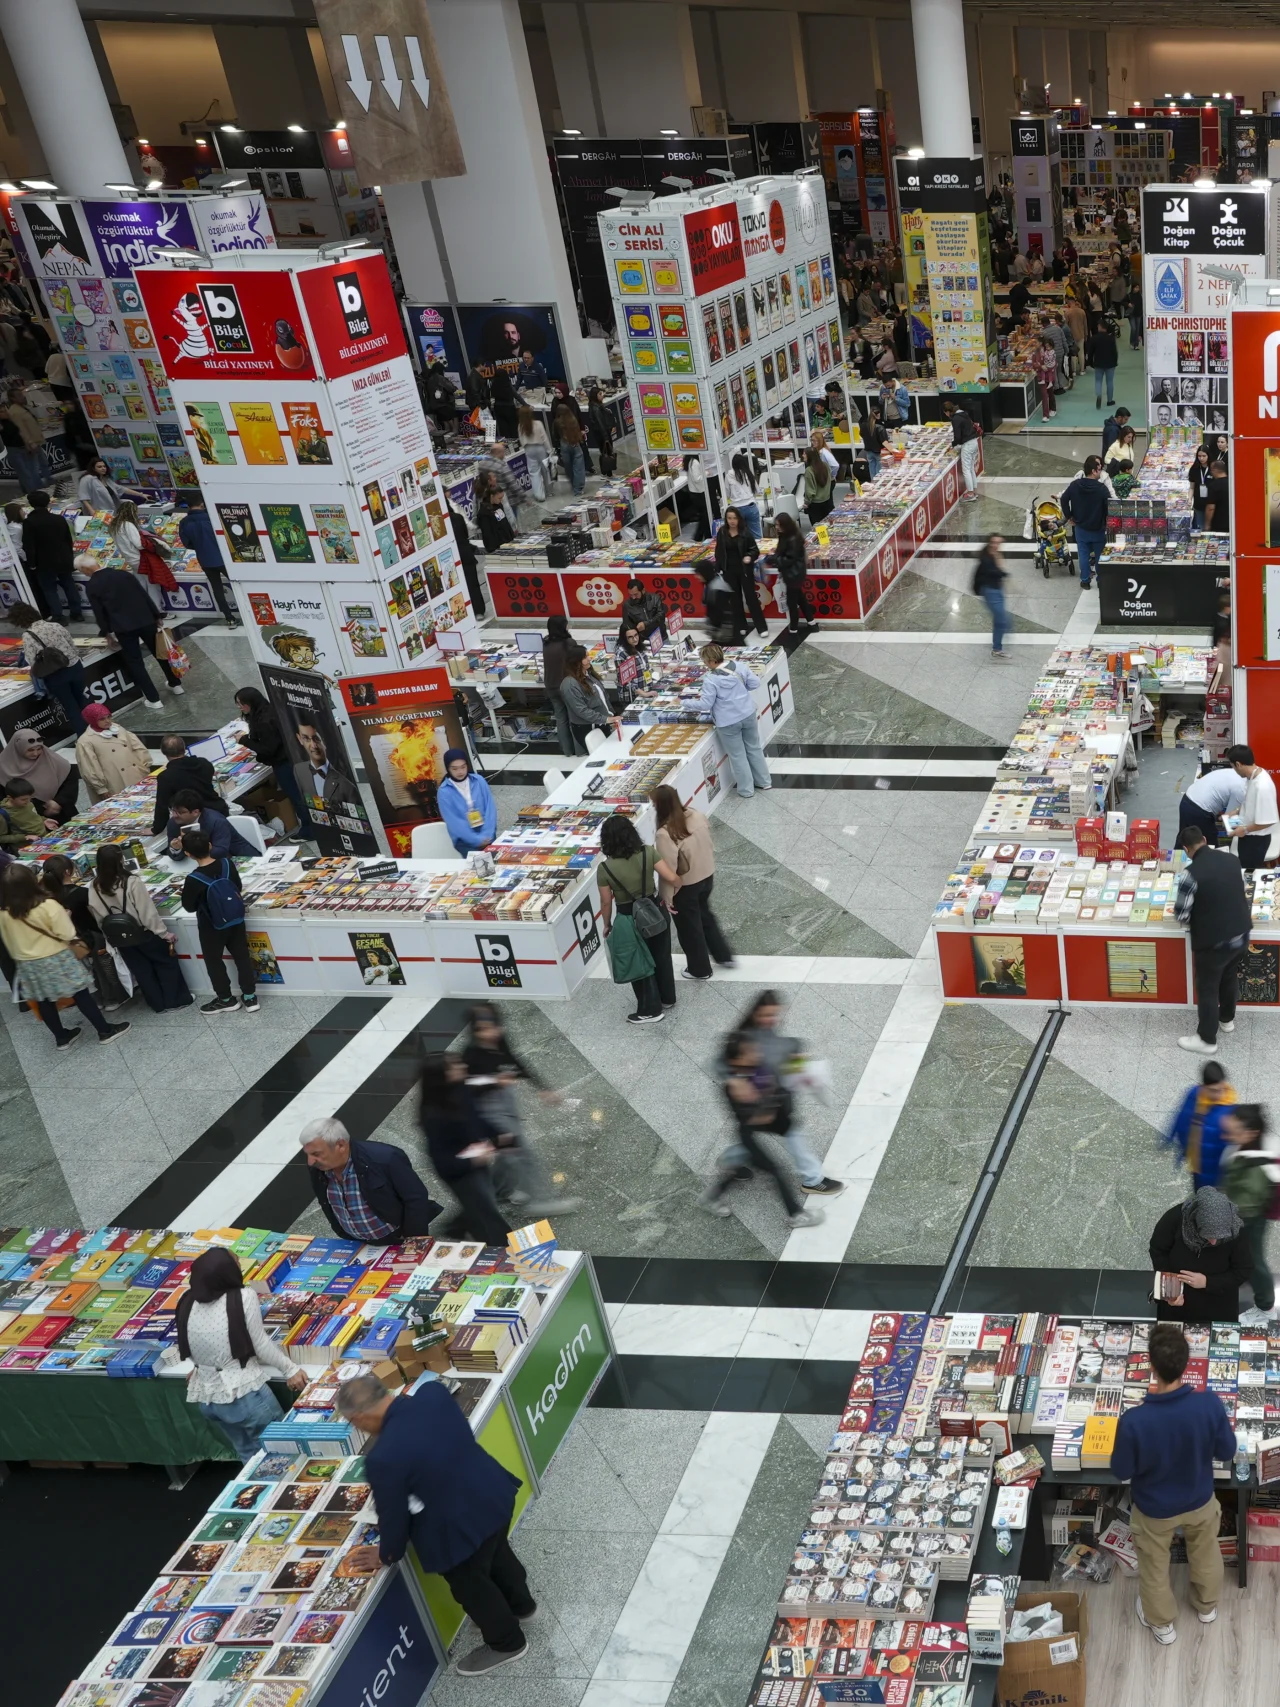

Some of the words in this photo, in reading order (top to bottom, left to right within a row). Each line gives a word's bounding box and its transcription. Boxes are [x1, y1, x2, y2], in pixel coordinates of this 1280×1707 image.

[667, 152, 703, 161] DERGÂH
[934, 174, 959, 183] YKY
[103, 211, 142, 222] okumak
[210, 210, 237, 222] okumak
[97, 224, 154, 237] özgürlüktür
[207, 222, 247, 237] özgürlüktür
[618, 222, 642, 236] CİN
[644, 222, 664, 236] ALİ
[1163, 225, 1196, 236] Doğan
[1211, 226, 1246, 237] Doğan
[936, 232, 966, 240] başlayan
[624, 239, 664, 251] SERİSİ
[937, 244, 966, 252] kitapları
[1163, 237, 1190, 249] Kitap
[1213, 236, 1245, 249] Çocuk
[43, 261, 96, 277] NEPAL
[348, 319, 370, 335] Bilgi
[1146, 316, 1227, 331] JEAN-CHRISTOPHE
[215, 324, 244, 340] Bilgi
[218, 339, 248, 351] Çocuk
[339, 344, 360, 360] BİLGİ
[360, 332, 390, 352] YAYINEVİ
[204, 360, 230, 370] BİLGİ
[231, 360, 274, 370] YAYINEVİ
[352, 378, 367, 392] İMZA
[272, 600, 296, 612] Hayri
[298, 600, 322, 610] Potur
[1124, 600, 1152, 610] Doğan
[1119, 608, 1157, 618] Yayınları
[378, 686, 411, 698] MUSTAFA
[412, 684, 438, 694] BALBAY
[361, 716, 394, 726] YILMAZ
[396, 710, 444, 723] ÖĞRETMEN
[582, 935, 600, 958] Bilgi
[488, 966, 516, 977] Bilgi
[490, 976, 520, 988] Çocuk
[525, 1322, 593, 1436] kadim
